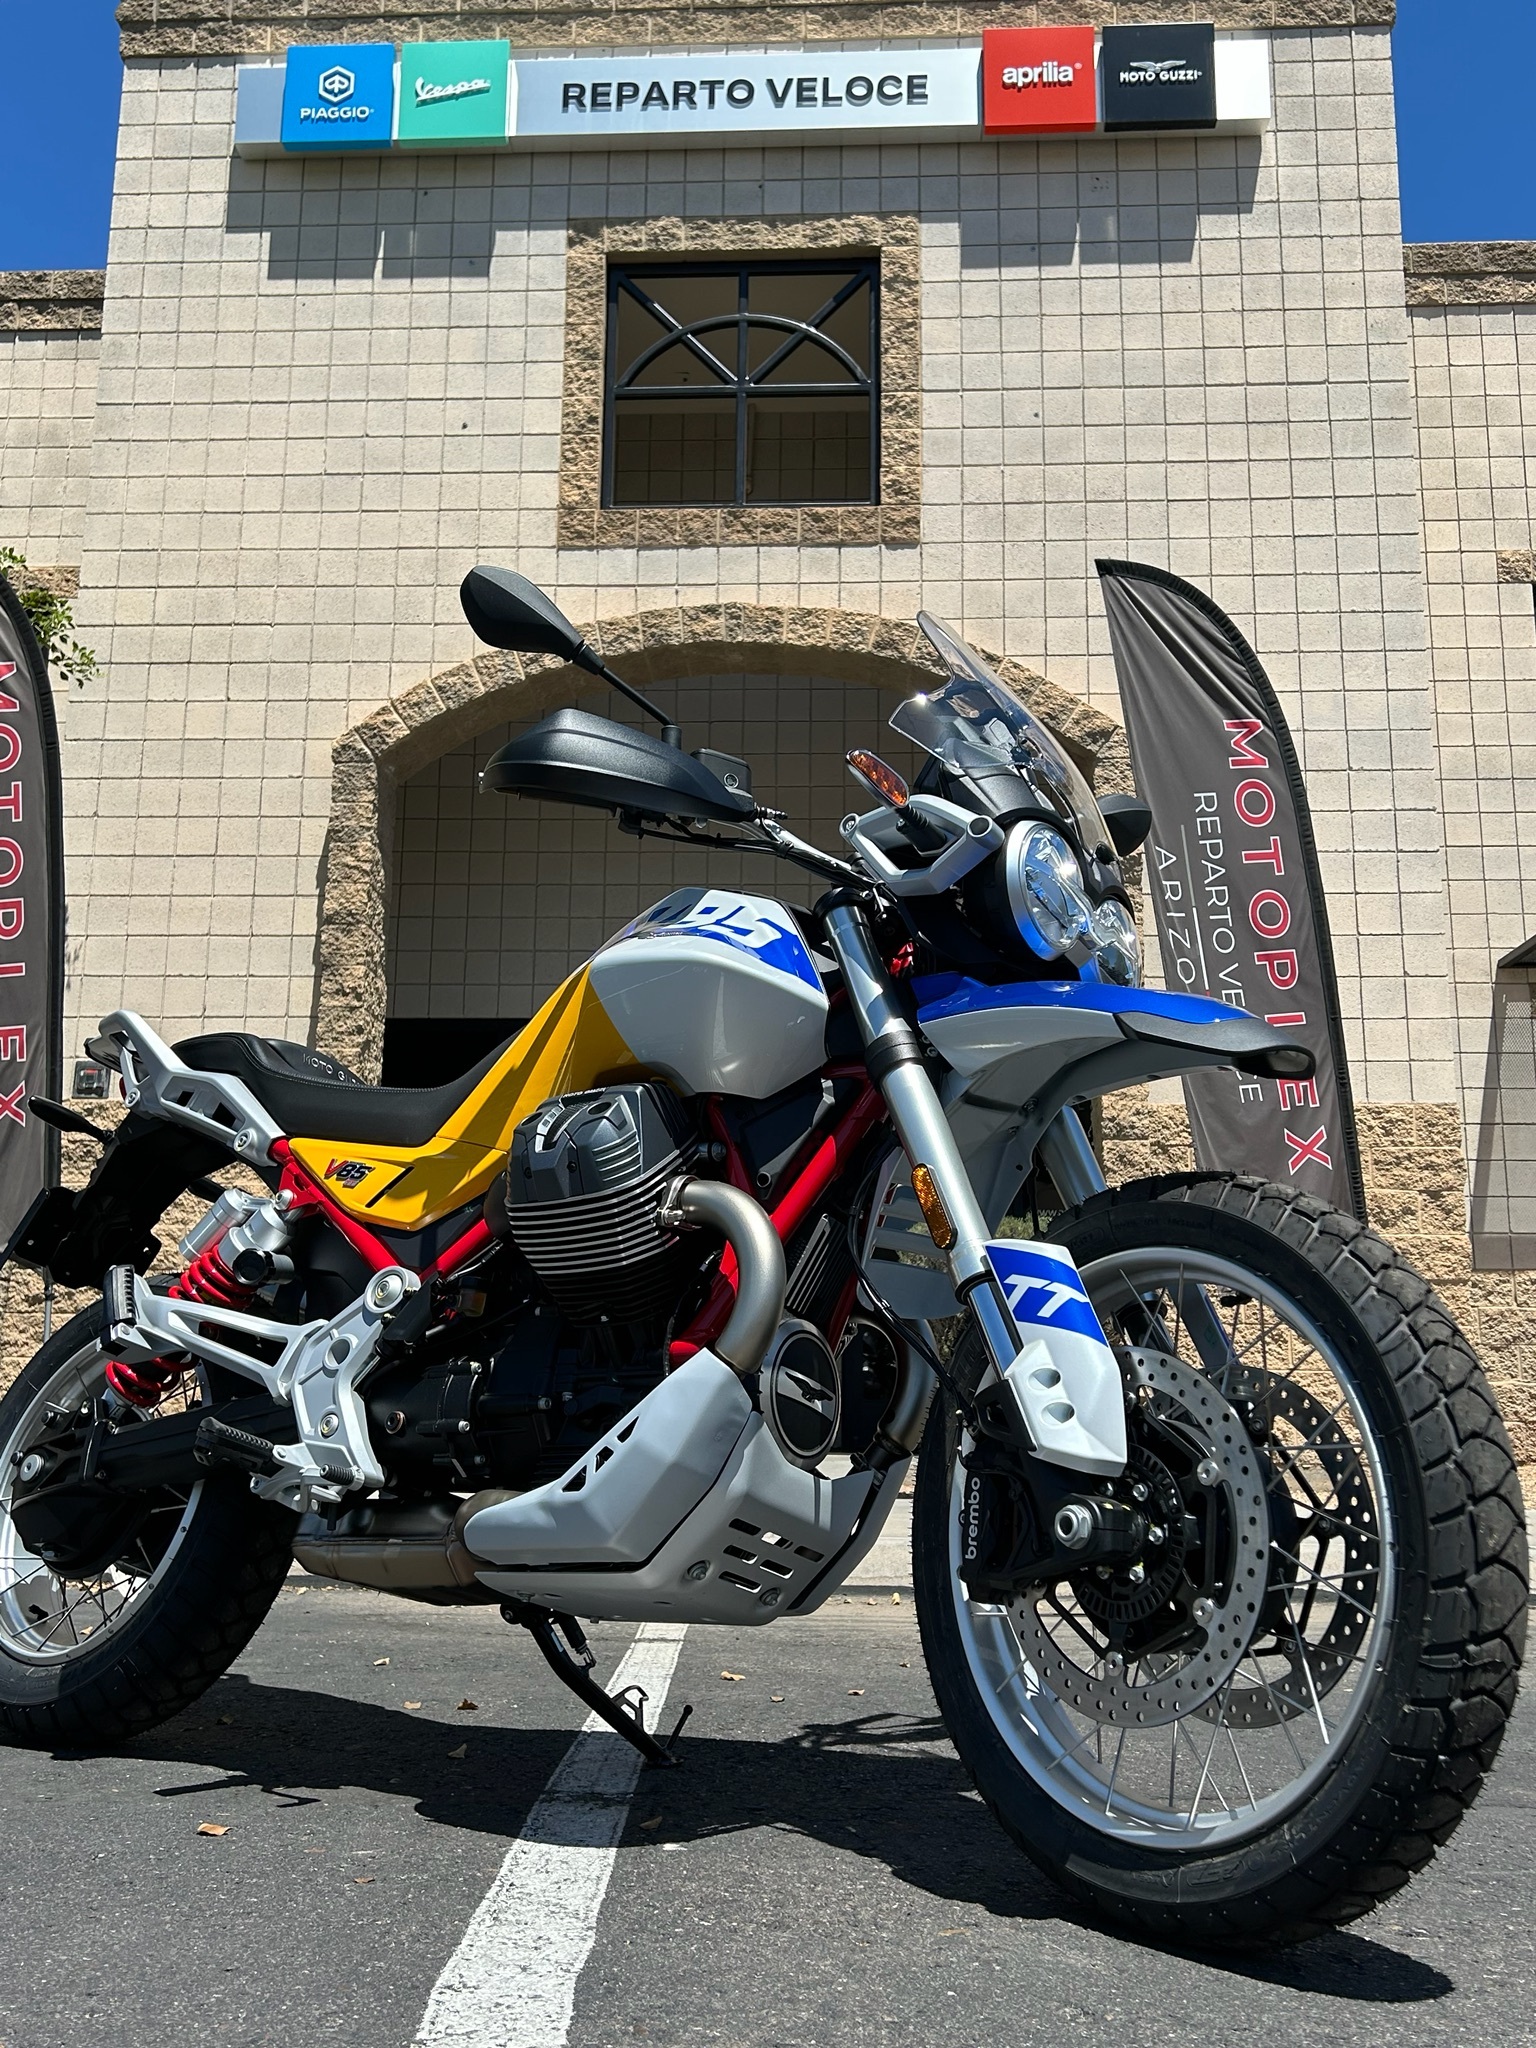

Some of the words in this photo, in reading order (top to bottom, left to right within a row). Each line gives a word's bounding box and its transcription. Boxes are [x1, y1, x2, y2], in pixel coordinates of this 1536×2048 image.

[1002, 61, 1074, 87] aprilia
[1119, 71, 1156, 82] MOTO
[1158, 69, 1202, 81] GUZZI
[414, 76, 491, 105] Vespa
[562, 80, 755, 114] REPARTO
[766, 73, 928, 108] VELOCE
[299, 106, 371, 121] PIAGGIO
[1193, 791, 1236, 954] REPARTO
[1218, 962, 1264, 1103] VEE
[324, 1158, 376, 1181] V85
[1003, 1273, 1090, 1319] TT
[964, 1476, 981, 1561] brembo
